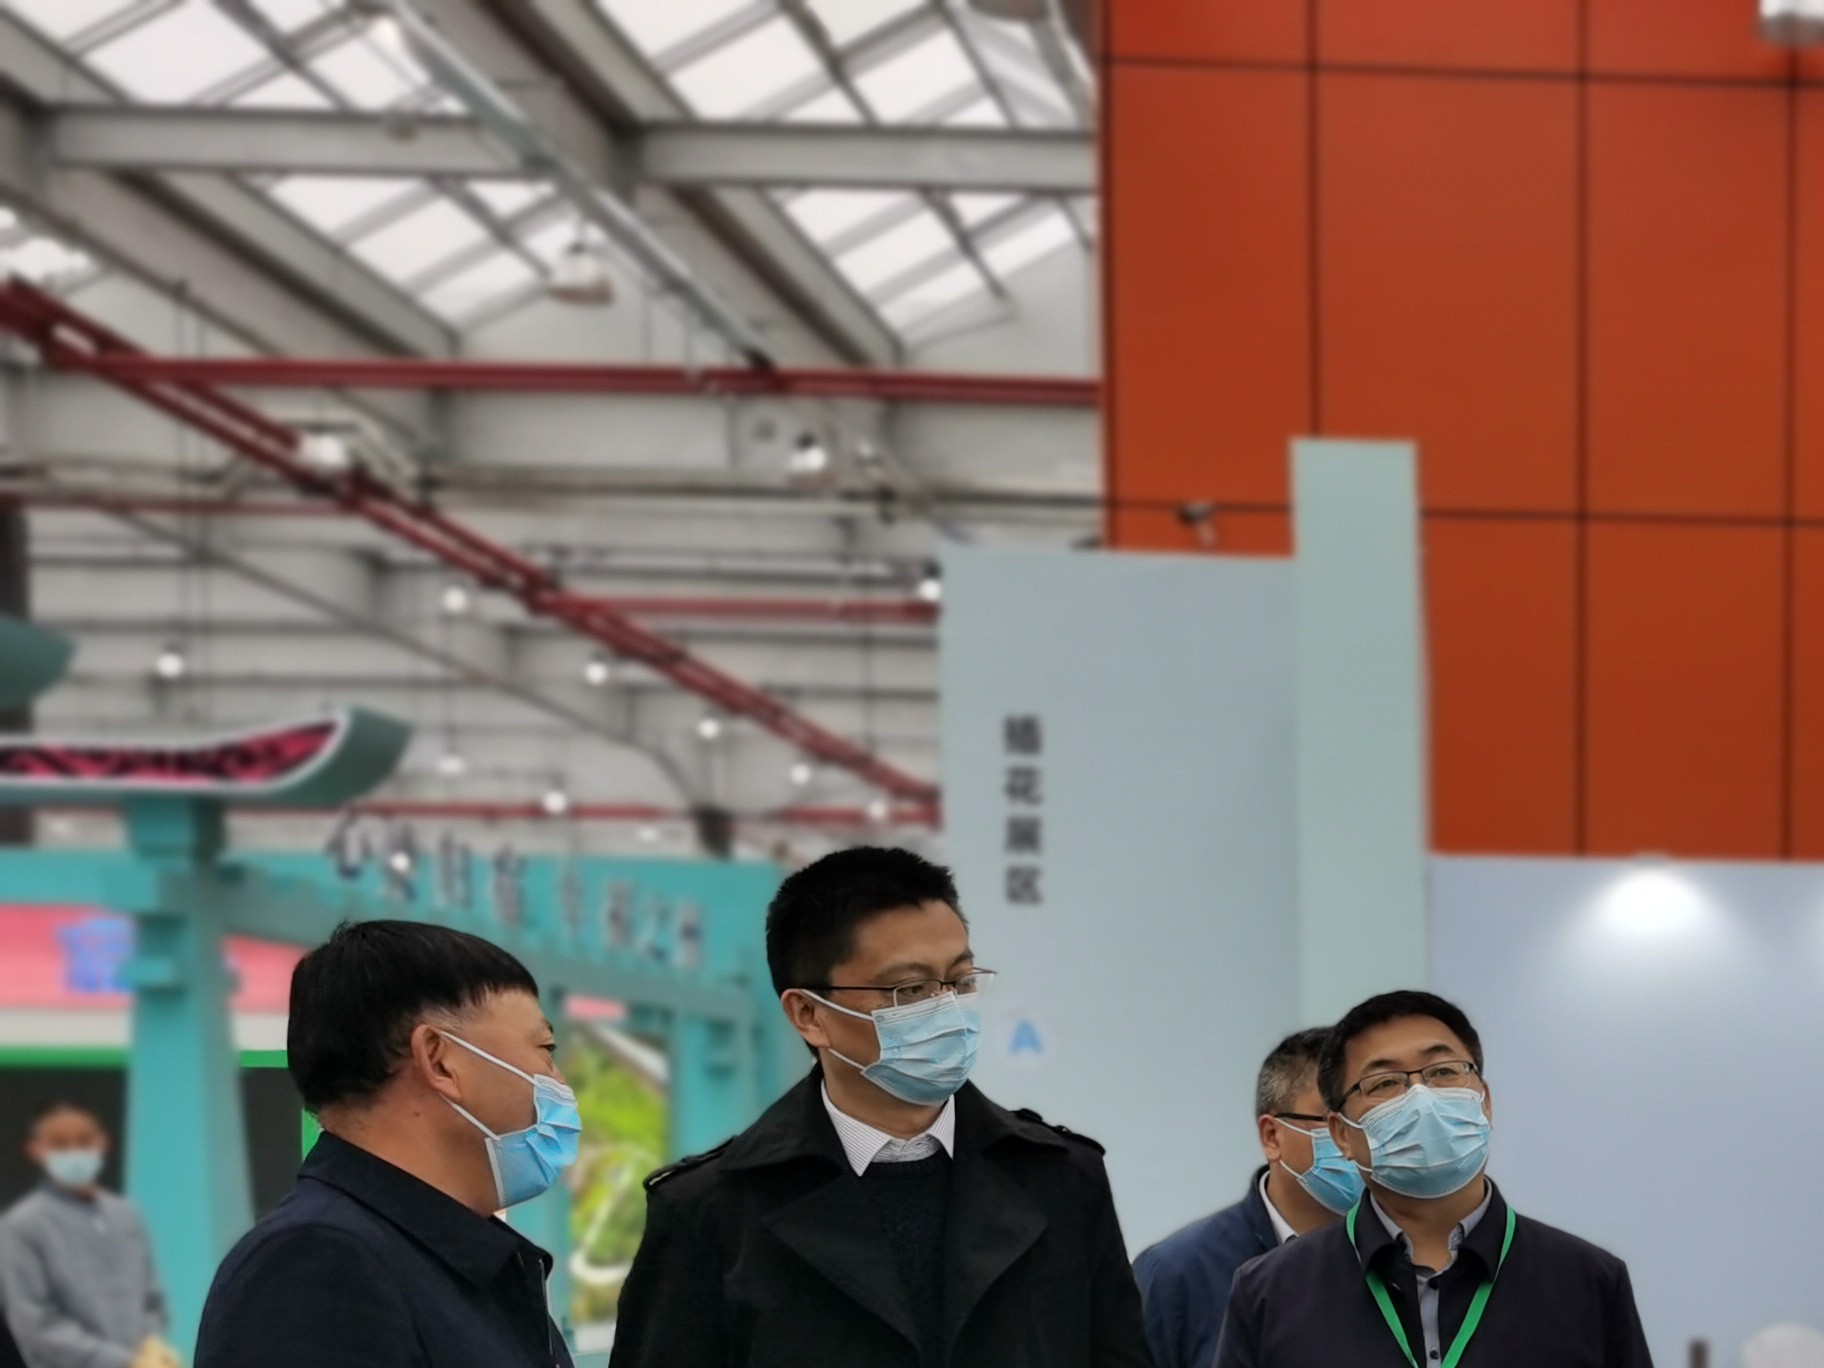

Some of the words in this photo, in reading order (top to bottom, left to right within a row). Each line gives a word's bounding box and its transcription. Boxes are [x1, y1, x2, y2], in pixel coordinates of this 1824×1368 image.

[1003, 715, 1043, 903] 插花展区
[1009, 1021, 1043, 1052] A
